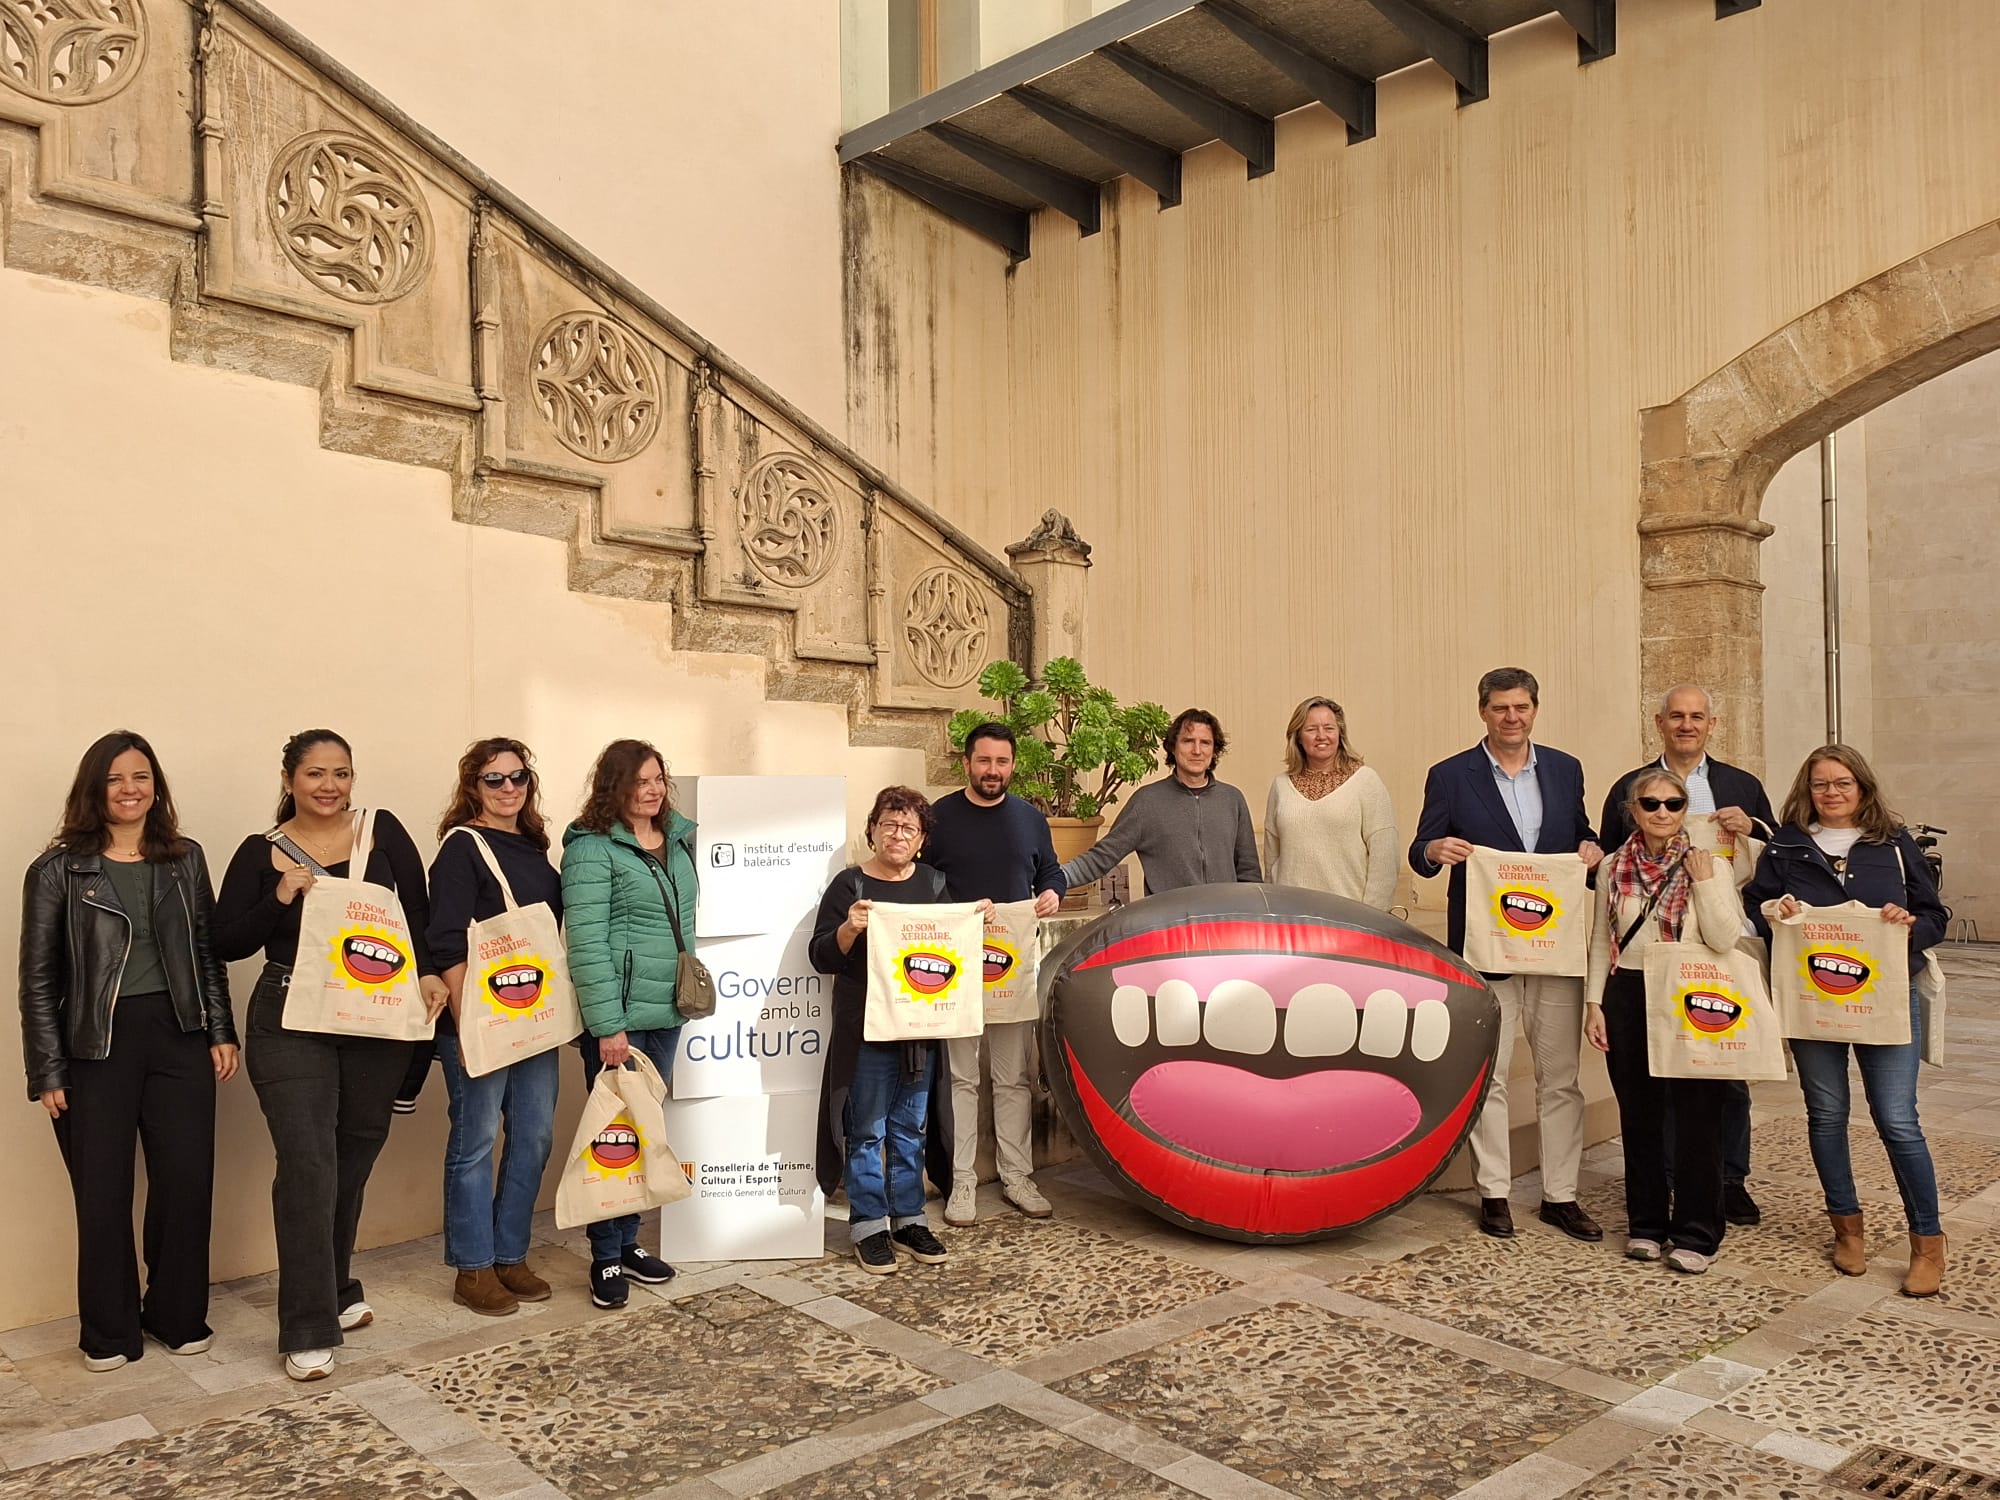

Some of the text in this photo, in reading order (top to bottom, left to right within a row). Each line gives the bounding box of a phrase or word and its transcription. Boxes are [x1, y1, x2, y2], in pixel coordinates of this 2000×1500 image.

[743, 841, 834, 854] institut d'estudis
[743, 856, 791, 867] baleàrics
[1497, 864, 1533, 872] JO SOM
[1497, 872, 1550, 882] XERRAIRE,
[346, 900, 387, 917] JO SOM
[344, 911, 404, 931] XERRAIRE,
[901, 923, 936, 932] JO SOM
[984, 925, 1008, 934] AIRE,
[1801, 923, 1843, 932] JO SOM
[489, 933, 513, 948] SOM
[1802, 932, 1864, 942] XERRAIRE,
[1536, 940, 1556, 949] TU?
[1680, 962, 1718, 971] JO SOM
[1680, 971, 1734, 983] XERRAIRE,
[718, 970, 821, 999] Govern
[379, 995, 402, 1007] TU?
[939, 1002, 957, 1011] TU?
[760, 1000, 821, 1020] amb la
[1851, 1005, 1873, 1015] TU?
[686, 1020, 821, 1062] cultura
[1726, 1042, 1747, 1051] TU?
[701, 1161, 814, 1173] Conselleria de Turisme,
[633, 1174, 647, 1184] TU
[701, 1175, 736, 1185] Cultura
[745, 1174, 783, 1186] Esports
[701, 1186, 807, 1198] Direcció General de Cultura
